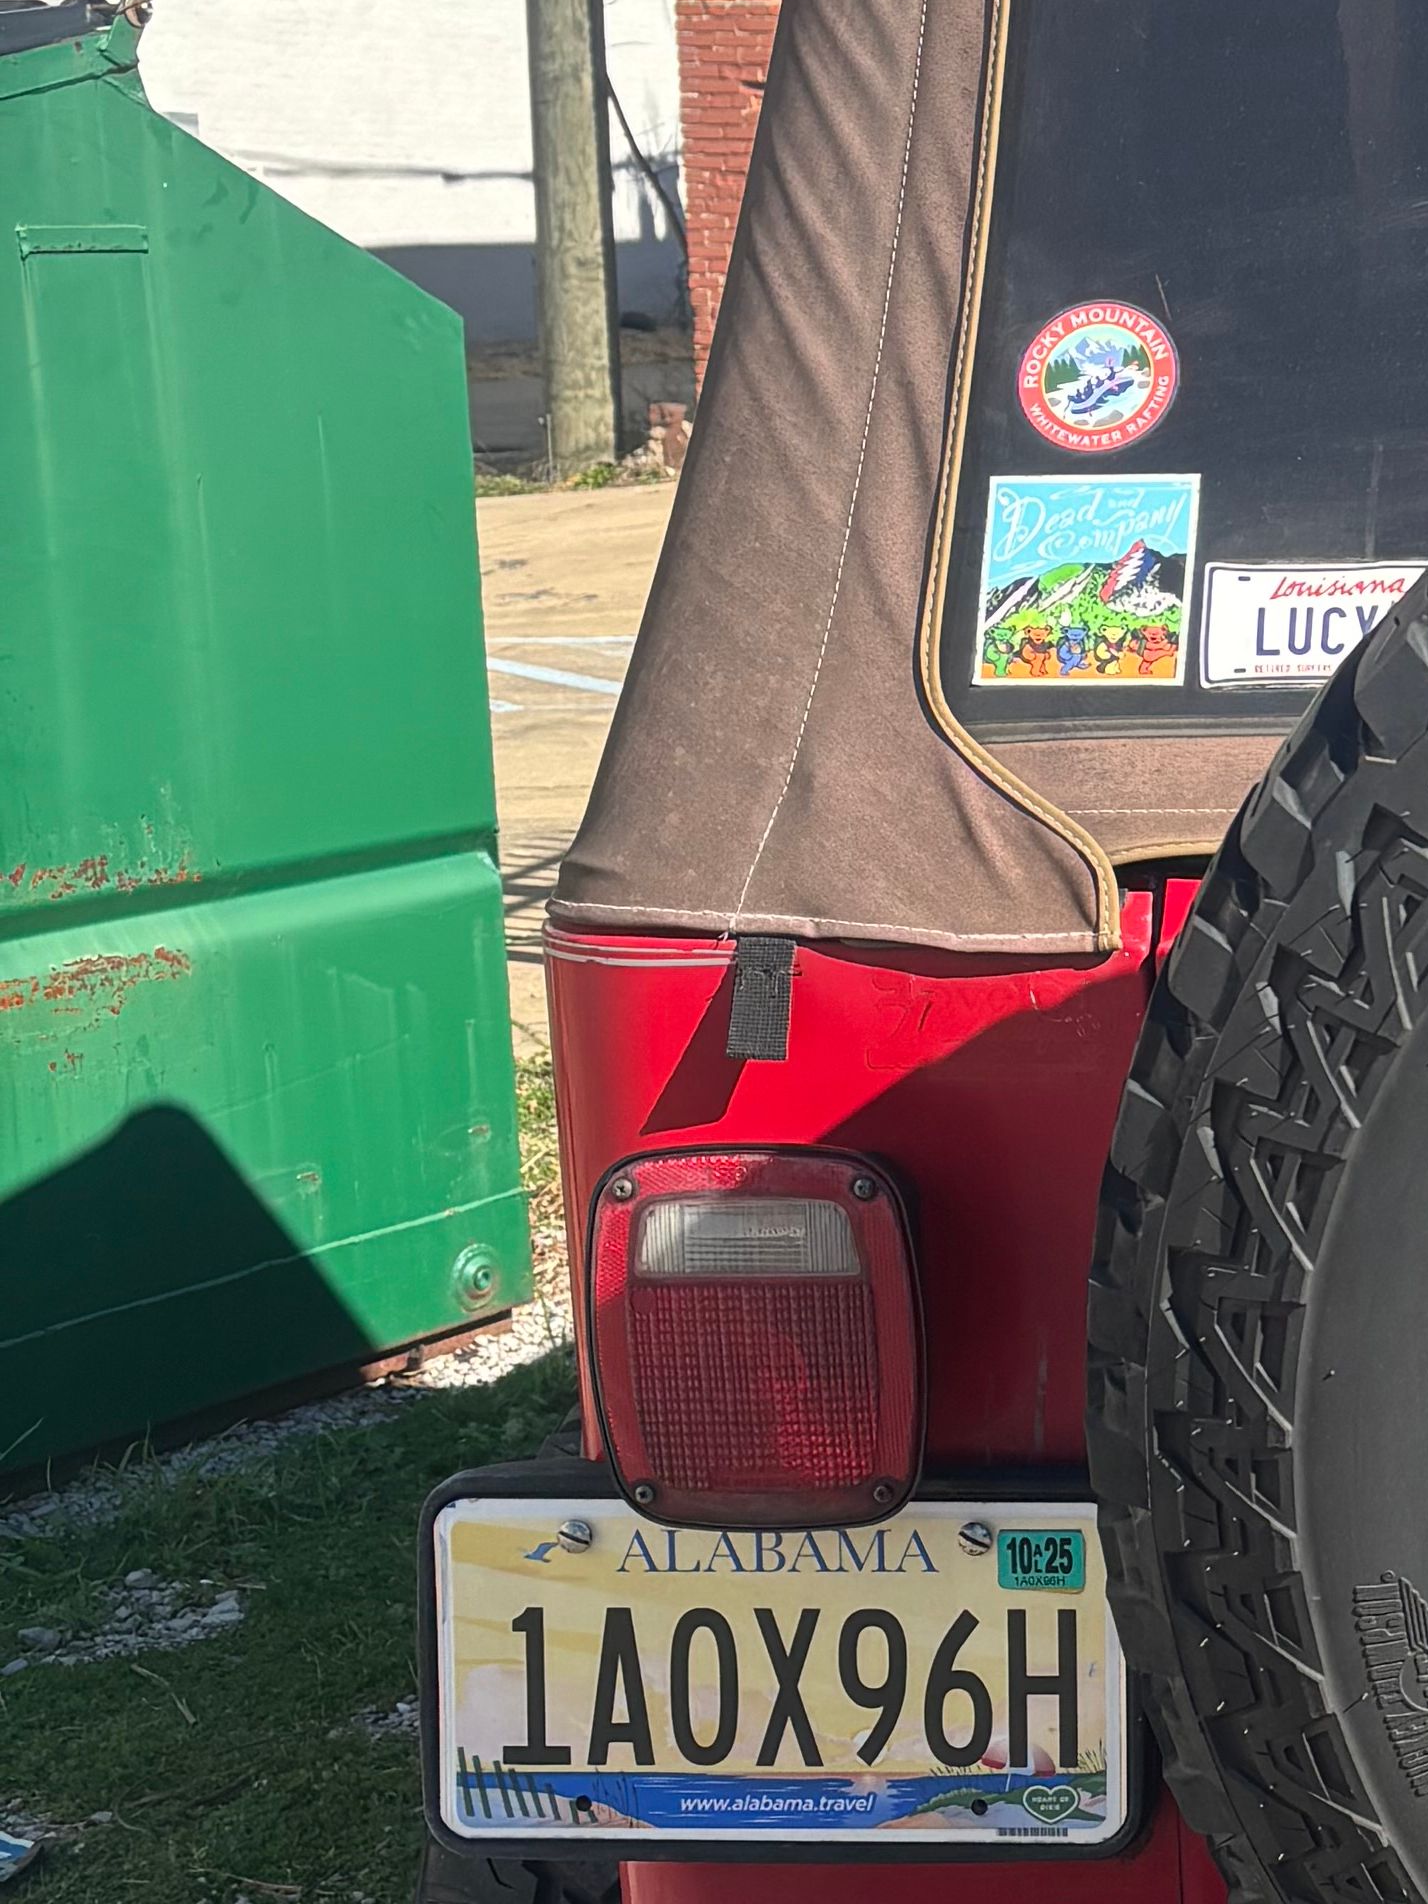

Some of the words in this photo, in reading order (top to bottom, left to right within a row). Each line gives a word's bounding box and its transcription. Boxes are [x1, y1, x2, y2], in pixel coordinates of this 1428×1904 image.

[1023, 322, 1066, 389] ROCKY
[1069, 307, 1170, 361] MOUNTAIN
[1029, 403, 1123, 447] WHITEWATER
[1126, 375, 1170, 435] RAFTING
[993, 487, 1104, 562] Dead
[1269, 575, 1407, 600] Louisiana
[616, 1529, 939, 1574] ALABAMA
[1007, 1537, 1032, 1574] 10
[1044, 1537, 1073, 1574] 25
[680, 1794, 874, 1814] www.alabama.travel
